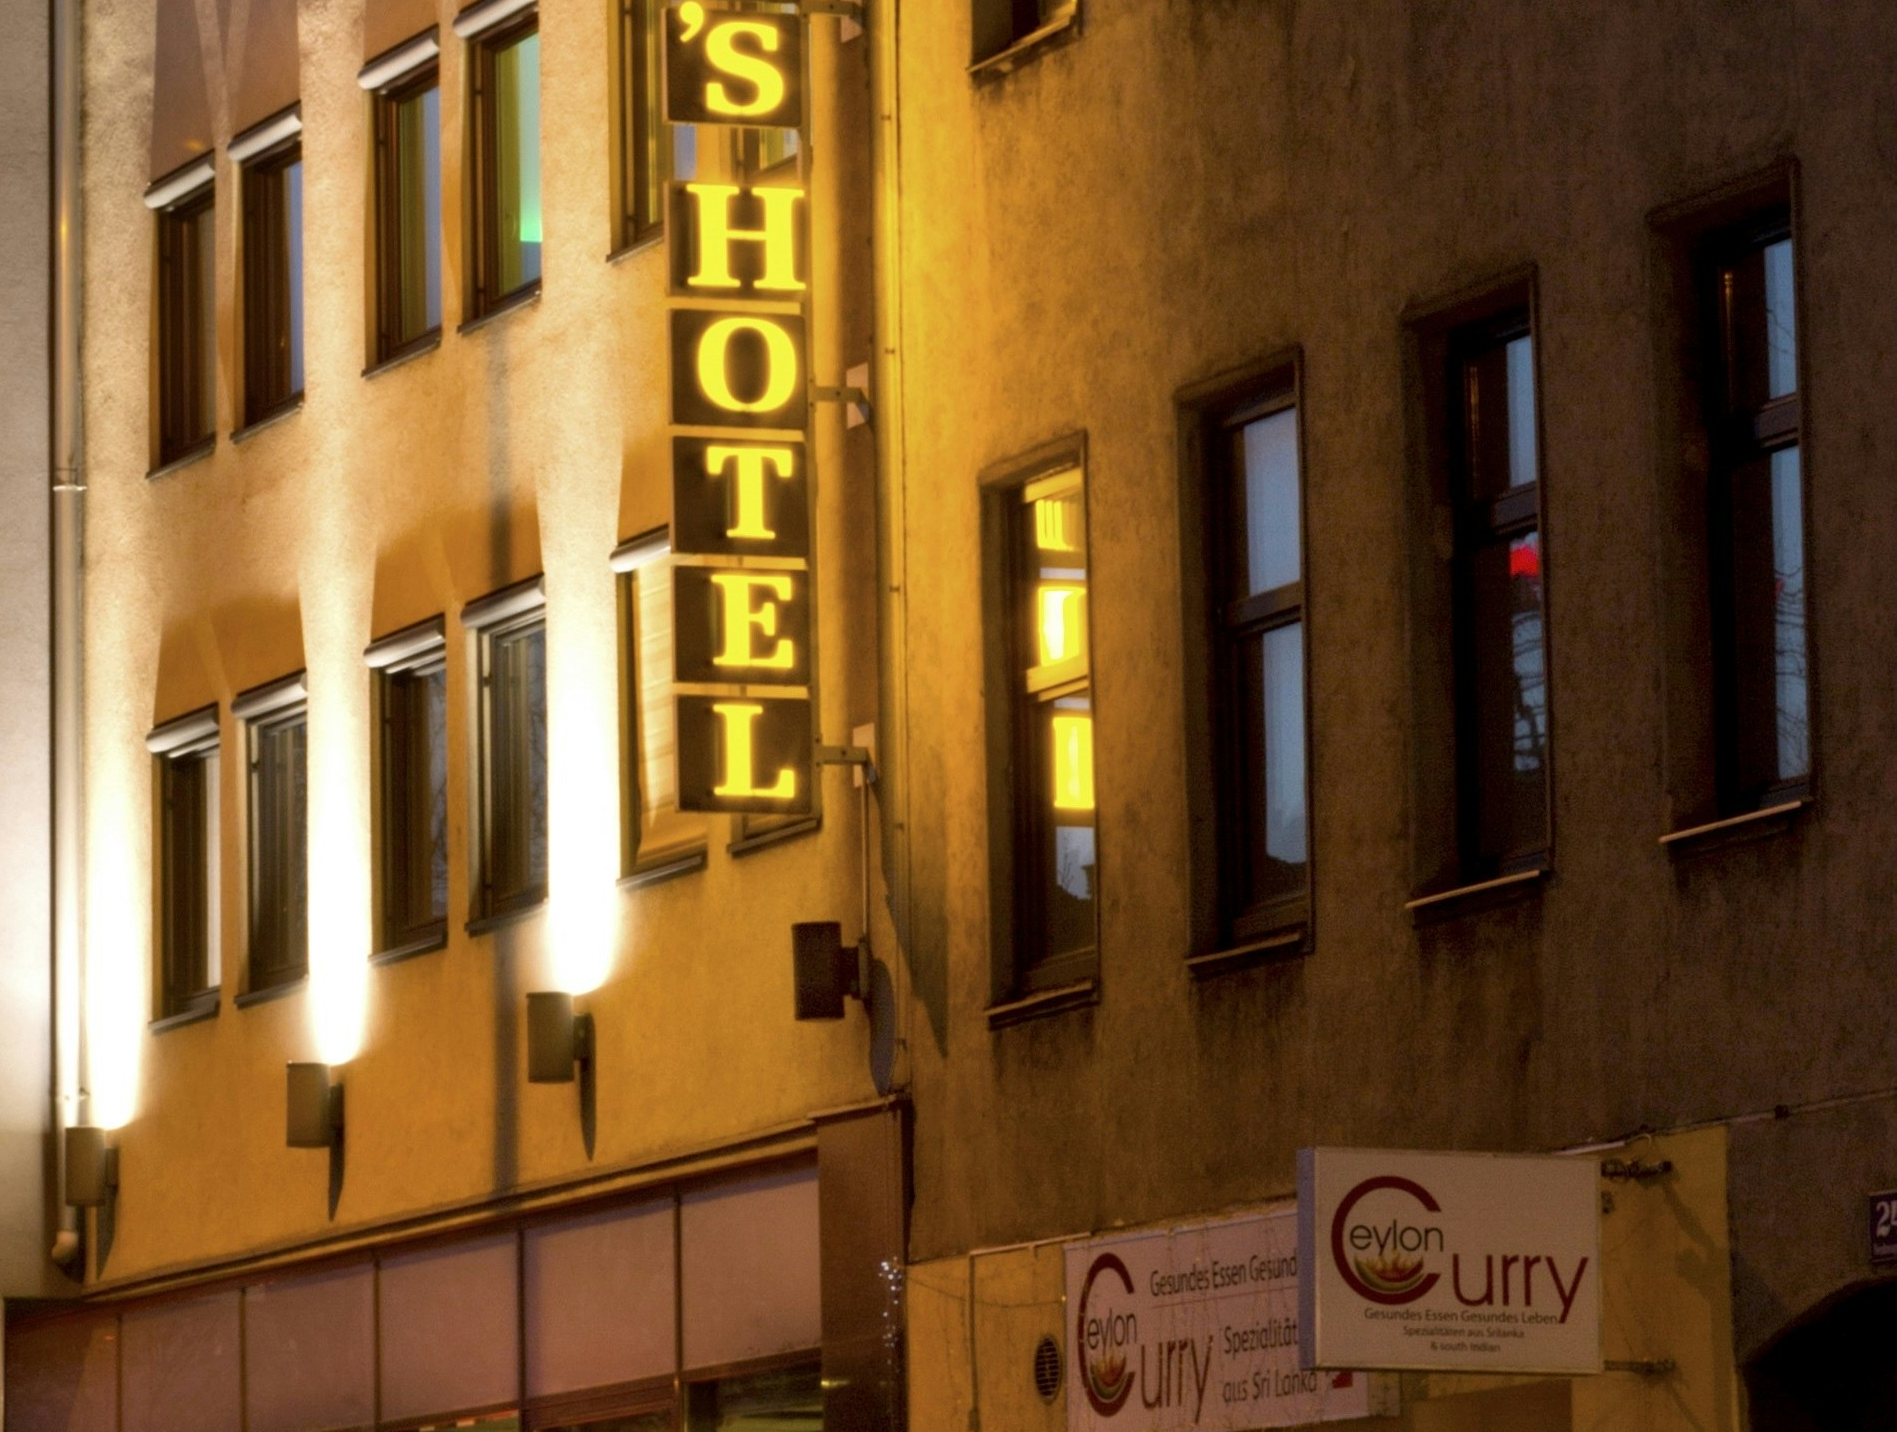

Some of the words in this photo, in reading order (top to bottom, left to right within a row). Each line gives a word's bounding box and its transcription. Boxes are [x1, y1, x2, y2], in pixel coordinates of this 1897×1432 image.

[686, 182, 806, 799] HOTEL
[1150, 1268, 1210, 1296] Gesundes
[1213, 1260, 1248, 1289] Essen
[1249, 1253, 1298, 1284] Gesund
[1364, 1307, 1422, 1322] Gesundes
[1425, 1309, 1458, 1323] Essen
[1461, 1310, 1519, 1325] Gesundes
[1224, 1317, 1297, 1359] Spezialität
[1440, 1342, 1467, 1353] south
[1470, 1342, 1501, 1353] Indian
[1467, 1329, 1484, 1339] aus
[1253, 1371, 1272, 1400] Sri
